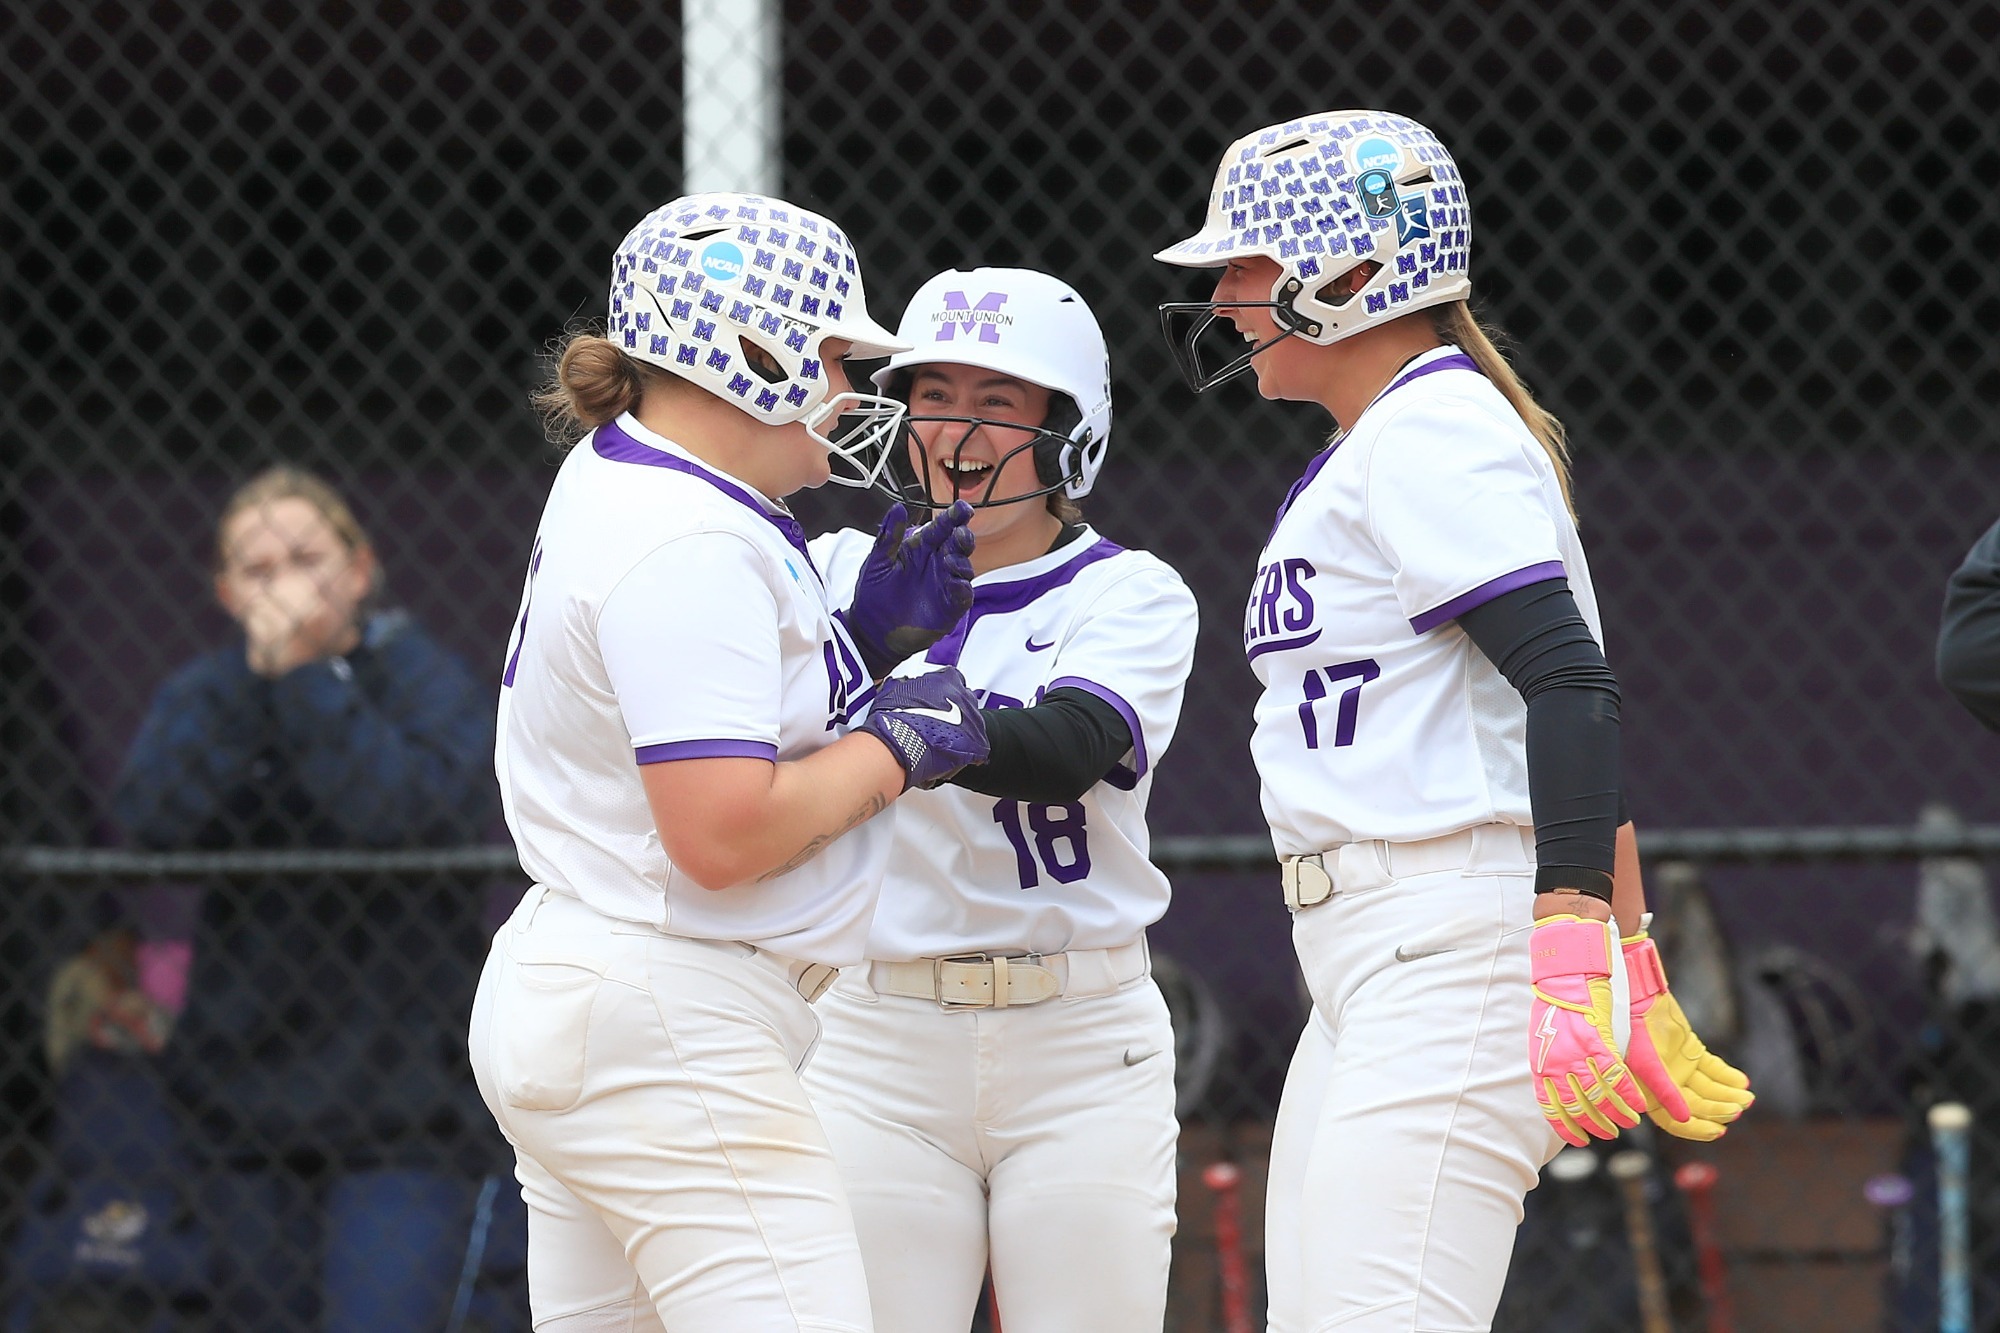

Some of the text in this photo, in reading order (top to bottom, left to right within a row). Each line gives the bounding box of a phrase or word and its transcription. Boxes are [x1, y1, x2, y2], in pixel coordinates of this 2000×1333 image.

[1308, 121, 1329, 134] M
[1328, 125, 1353, 141] M
[1349, 119, 1373, 133] M
[1240, 145, 1258, 163] M
[1318, 140, 1343, 161] M
[1244, 163, 1263, 181] M
[1274, 159, 1295, 178] M
[1299, 156, 1322, 177] M
[1325, 160, 1347, 181] M
[1362, 153, 1399, 170] NCAA
[1227, 165, 1241, 184] M
[1239, 184, 1255, 204] M
[1260, 176, 1281, 197] M
[1285, 178, 1307, 198] M
[1310, 177, 1332, 195] M
[1431, 187, 1449, 205] M
[1222, 190, 1235, 211] M
[1252, 200, 1271, 222] M
[1274, 199, 1296, 220] M
[1301, 196, 1323, 216] M
[1329, 195, 1352, 216] M
[705, 205, 730, 221] M
[737, 206, 758, 221] M
[770, 209, 788, 223] M
[1231, 210, 1246, 229] M
[1342, 212, 1362, 233] M
[1430, 208, 1448, 229] M
[737, 225, 760, 245] M
[1263, 222, 1284, 244] M
[1291, 216, 1313, 237] M
[1316, 214, 1338, 235] M
[767, 227, 789, 249] M
[795, 235, 817, 258] M
[1215, 235, 1235, 252] M
[1240, 228, 1259, 246] M
[1303, 235, 1325, 254] M
[1328, 232, 1348, 256] M
[1350, 233, 1375, 256] M
[1440, 230, 1453, 249] M
[652, 241, 675, 261] M
[673, 247, 693, 267] M
[823, 246, 840, 270] M
[1279, 237, 1300, 259] M
[1420, 242, 1436, 263] M
[703, 256, 742, 276] NCAA
[753, 249, 776, 271] M
[782, 258, 803, 281] M
[1297, 256, 1320, 279] M
[1396, 253, 1417, 275] M
[657, 274, 677, 295] M
[681, 270, 705, 293] M
[742, 274, 766, 298] M
[809, 267, 828, 291] M
[700, 289, 724, 313] M
[771, 284, 793, 308] M
[1365, 291, 1387, 314] M
[1389, 282, 1409, 303] M
[670, 298, 692, 321] M
[729, 300, 753, 324] M
[800, 294, 820, 317] M
[826, 299, 842, 321] M
[635, 312, 651, 332] M
[758, 311, 782, 336] M
[931, 311, 1013, 326] MOUNT UNION
[624, 328, 636, 348] M
[692, 318, 716, 342] M
[784, 328, 808, 353] M
[650, 334, 668, 355] M
[676, 343, 698, 366] M
[706, 347, 731, 372] M
[800, 358, 820, 380] M
[727, 372, 753, 397] M
[785, 383, 808, 407] M
[754, 388, 779, 412] M
[1245, 557, 1317, 645] ERS
[1298, 658, 1381, 749] 17
[992, 798, 1092, 890] 18
